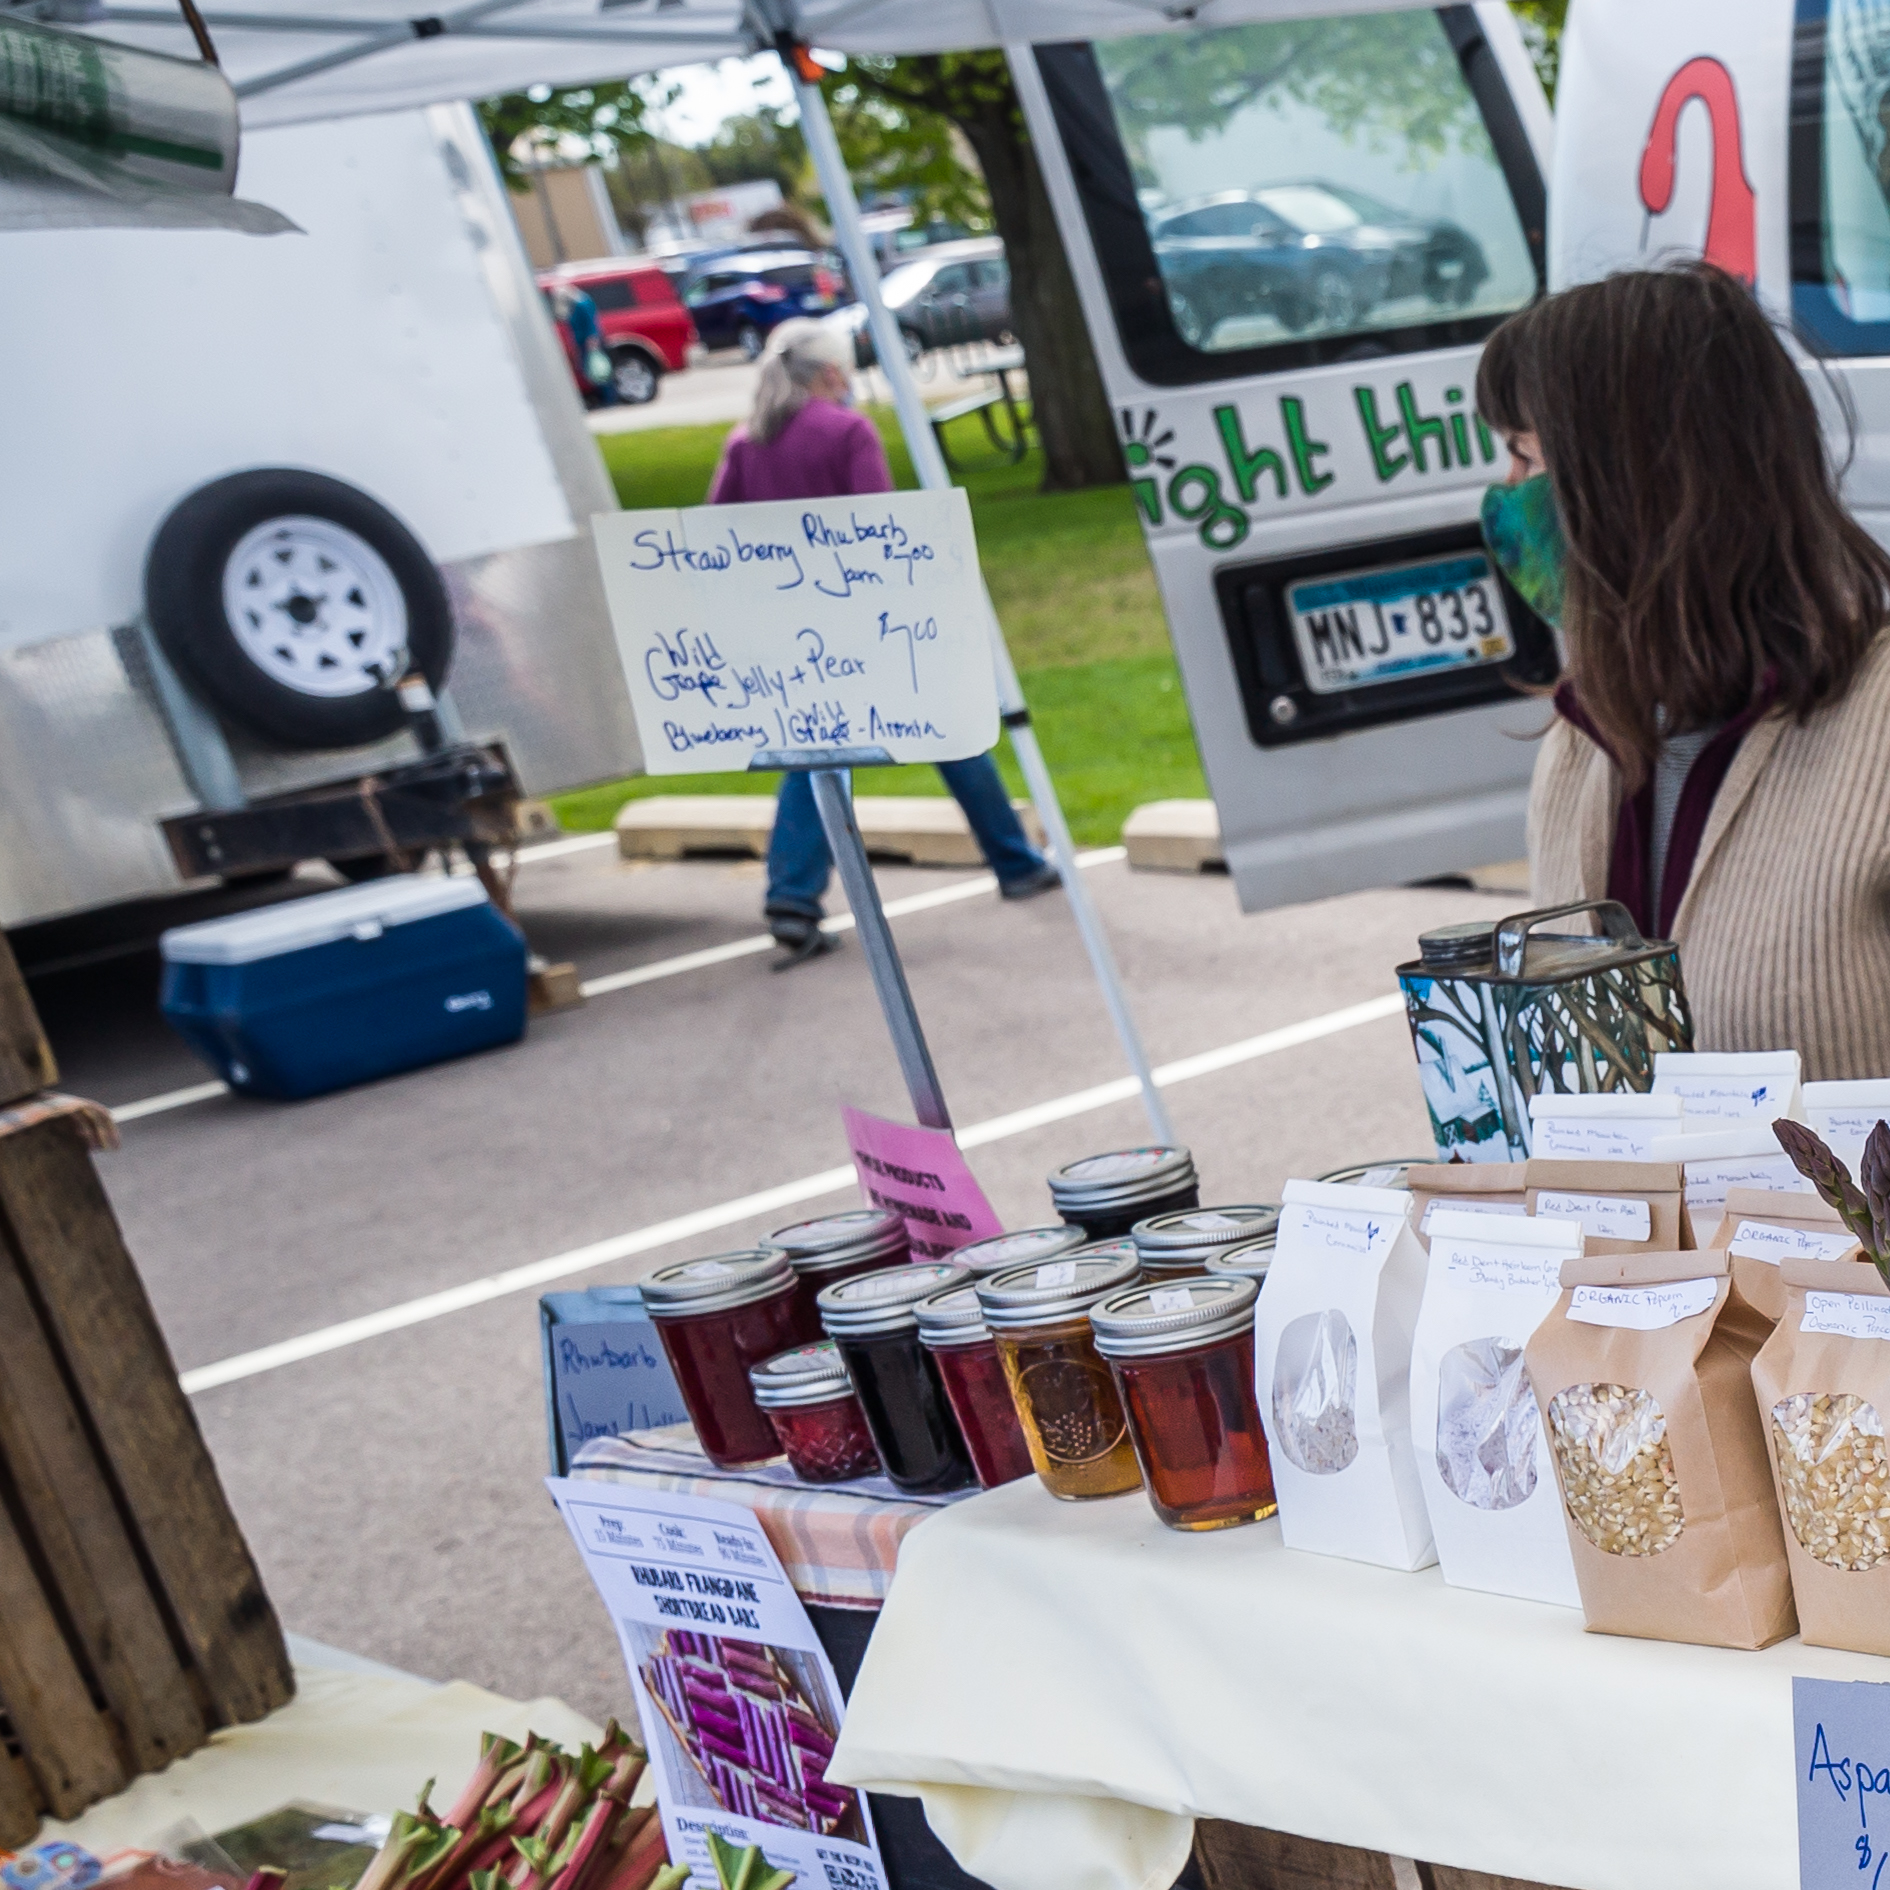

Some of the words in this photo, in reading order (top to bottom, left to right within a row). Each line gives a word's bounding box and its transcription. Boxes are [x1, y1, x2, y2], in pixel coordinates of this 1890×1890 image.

[630, 529, 804, 590] Strawberry
[802, 513, 908, 546] Rhubarb
[814, 552, 883, 598] Jam
[1305, 601, 1390, 667] MNJ
[1416, 585, 1494, 646] 833
[655, 629, 727, 671] Wild
[726, 665, 788, 709] Jelly
[796, 629, 866, 683] Pear
[1739, 1228, 1792, 1246] ORGANIC
[1576, 1290, 1640, 1306] ORGANIC
[1811, 1295, 1843, 1313] Open
[560, 1336, 657, 1375] Rhubarb
